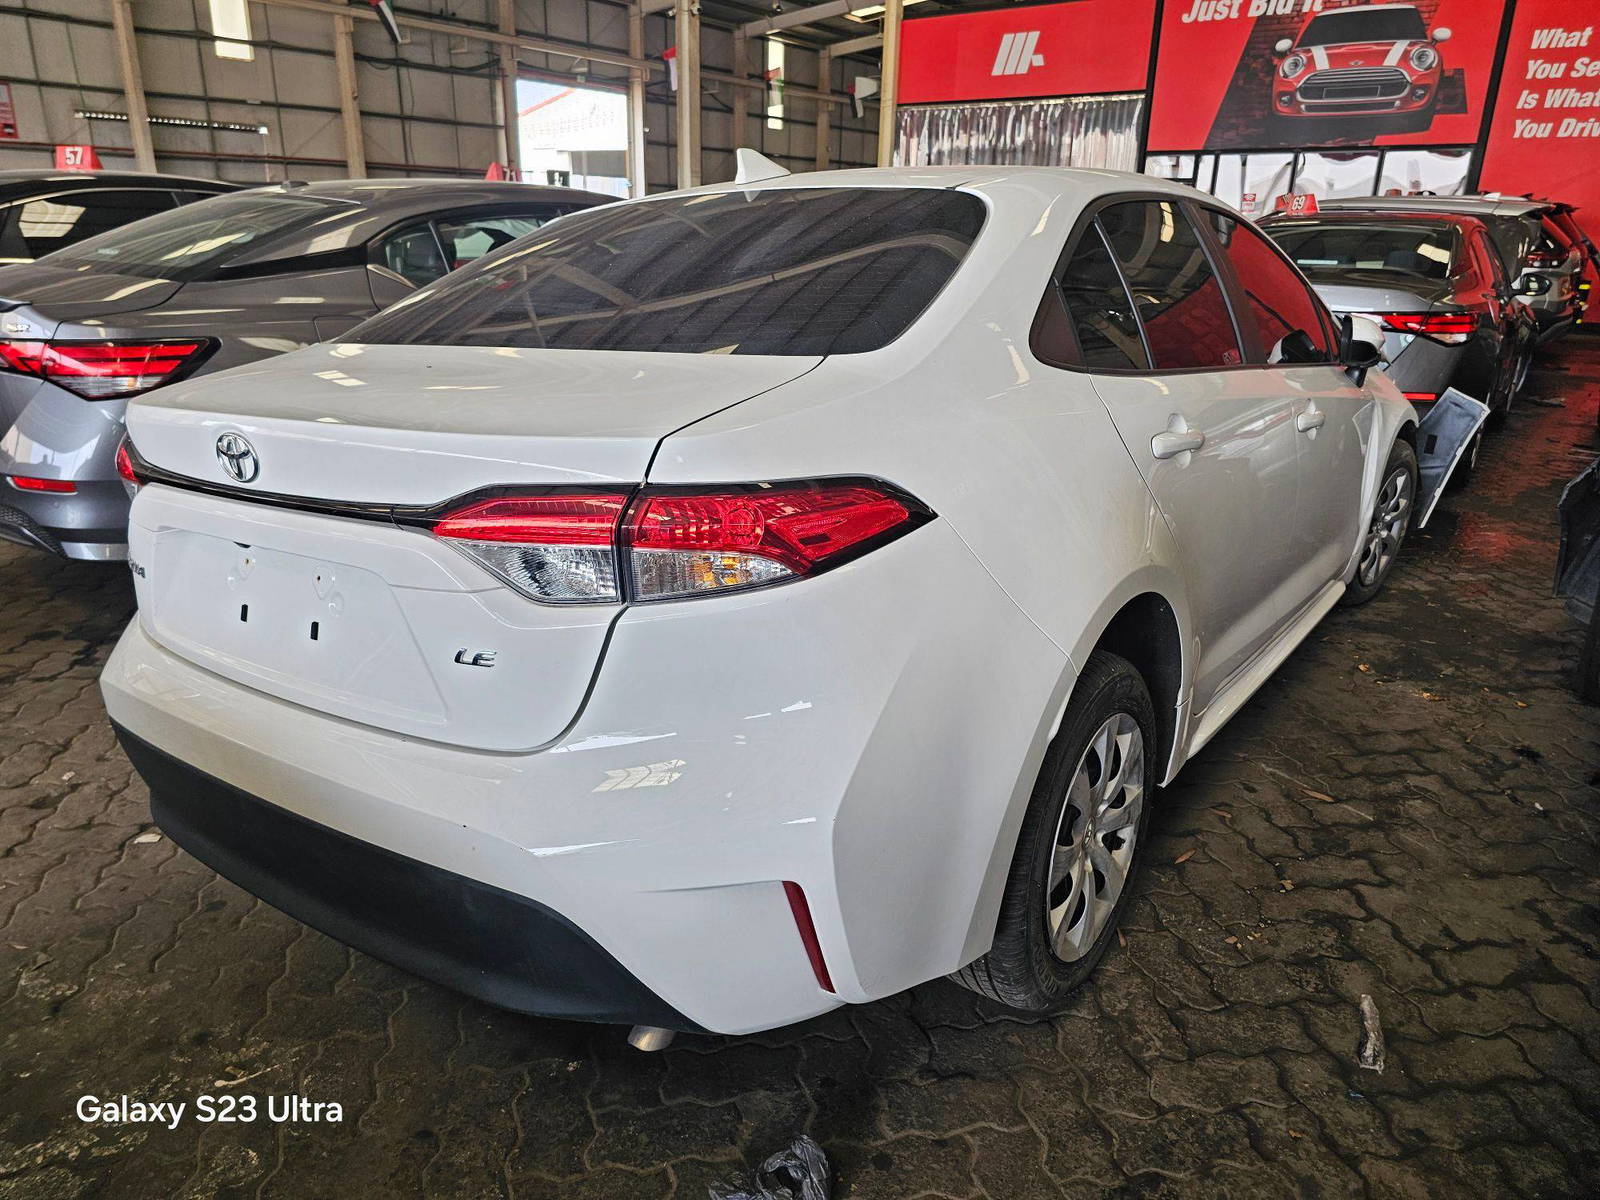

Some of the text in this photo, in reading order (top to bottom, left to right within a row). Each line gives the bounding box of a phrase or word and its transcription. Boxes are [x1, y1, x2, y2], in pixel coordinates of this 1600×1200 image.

[1181, 0, 1243, 24] Just
[1530, 26, 1594, 50] What
[1525, 56, 1600, 80] You Se
[1516, 87, 1600, 110] Is What
[1512, 119, 1554, 139] You
[64, 147, 84, 166] 57
[1291, 195, 1306, 211] 69
[453, 647, 497, 668] LE
